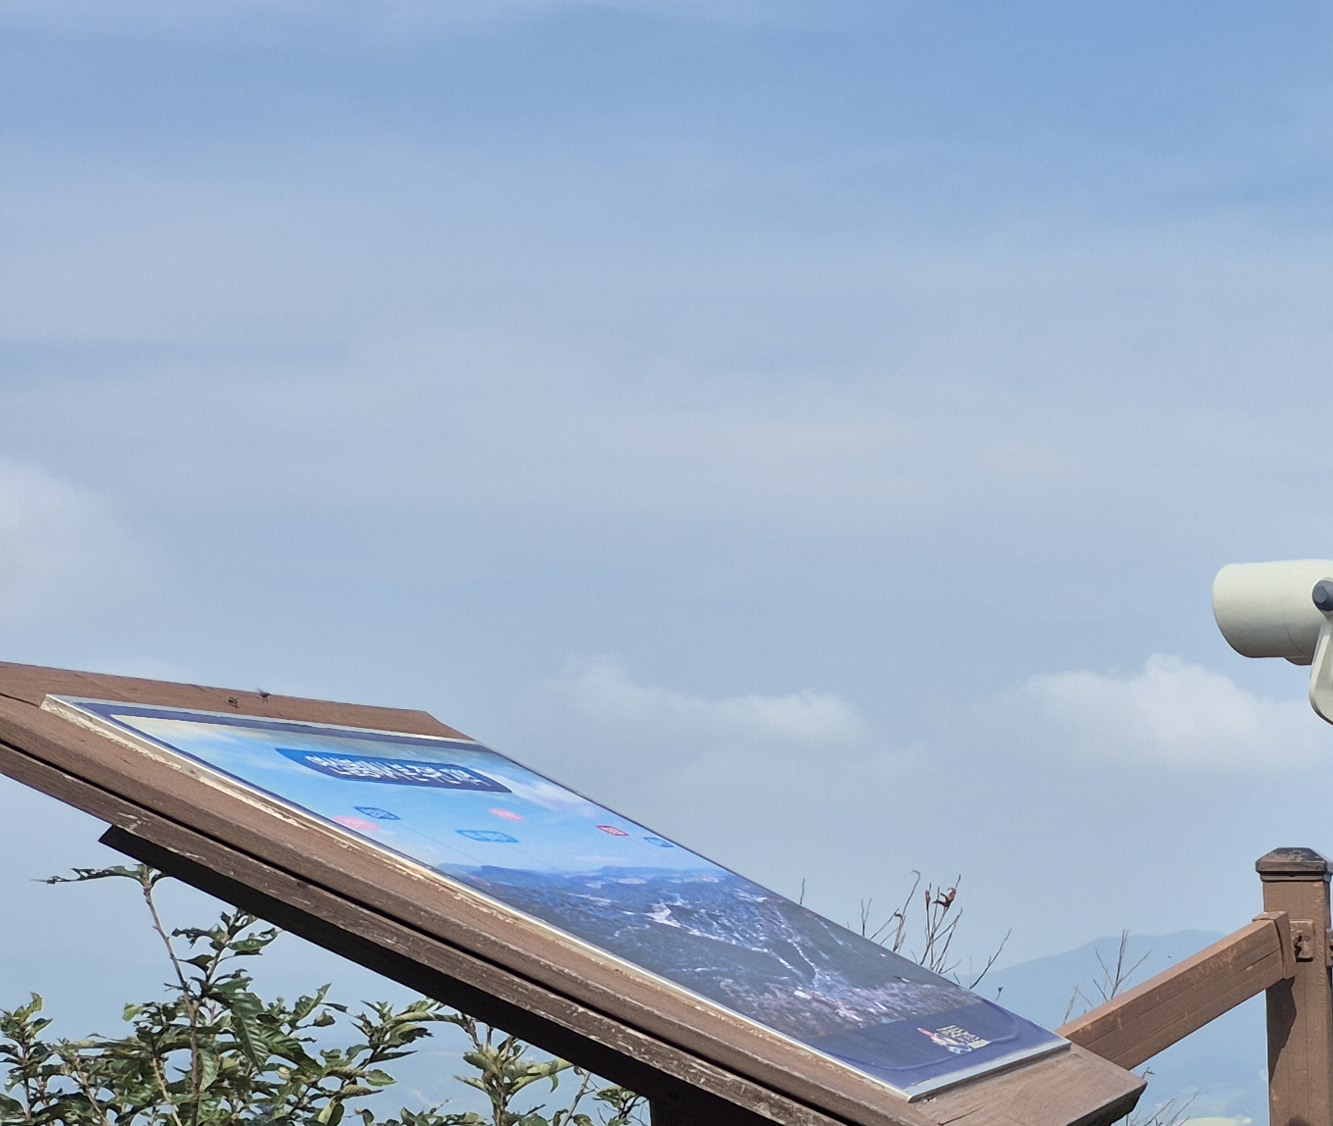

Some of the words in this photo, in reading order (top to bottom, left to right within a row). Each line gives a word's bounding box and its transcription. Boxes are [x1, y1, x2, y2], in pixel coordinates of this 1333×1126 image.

[305, 755, 411, 780] 연실봉에서
[387, 763, 430, 782] 본
[406, 764, 461, 785] 주변
[439, 768, 491, 787] 지역
